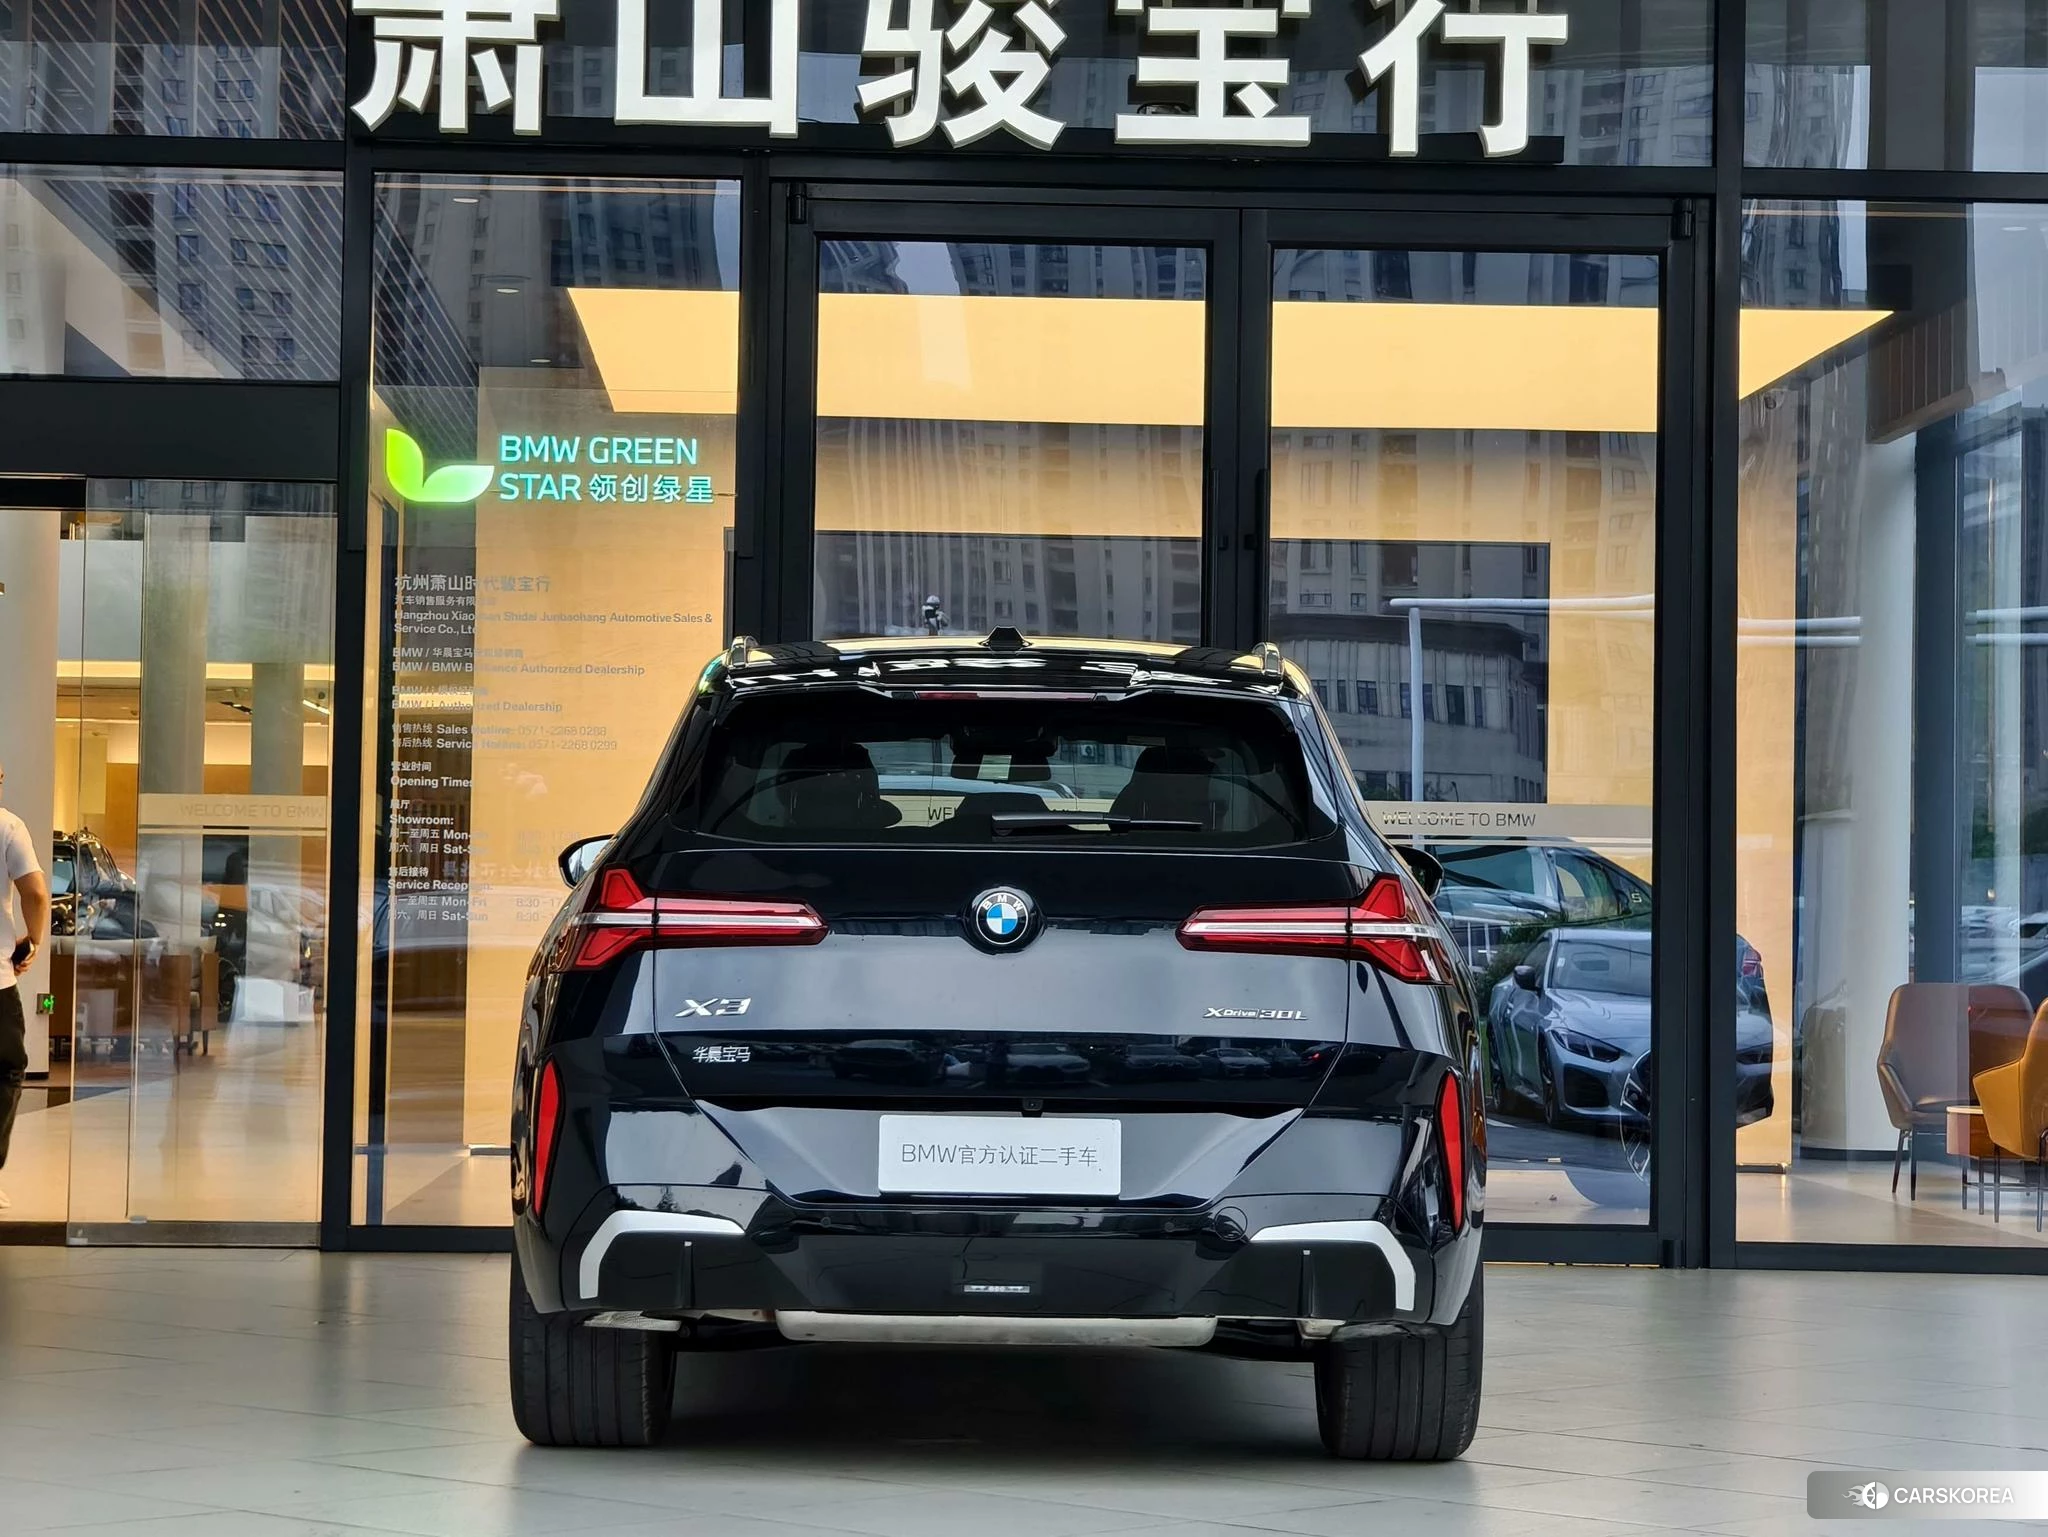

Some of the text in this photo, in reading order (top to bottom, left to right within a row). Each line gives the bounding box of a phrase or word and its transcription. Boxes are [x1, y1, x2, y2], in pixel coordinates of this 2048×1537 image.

[500, 435, 698, 465] BMW GREEN
[500, 473, 714, 503] STAR 领创绿星
[610, 612, 672, 623] Automotive
[673, 613, 703, 623] Sales
[704, 613, 713, 623] &
[394, 624, 436, 635] Service
[392, 647, 424, 658] BMW
[392, 661, 424, 672] BMW
[432, 662, 463, 673] BMW
[520, 663, 583, 674] Authorized
[585, 663, 645, 676] Dealership
[503, 701, 562, 712] Dealership
[436, 723, 468, 734] Sales
[391, 775, 439, 788] Opening
[262, 804, 282, 817] TO
[389, 814, 454, 826] Showroom:
[1382, 811, 1536, 827] WELCOME TO BMW
[388, 879, 430, 890] Service
[982, 894, 1025, 911] BMW
[675, 997, 752, 1018] X3
[692, 1045, 751, 1063] 华晨宝马
[901, 1143, 1098, 1168] BMW官方认证二手车
